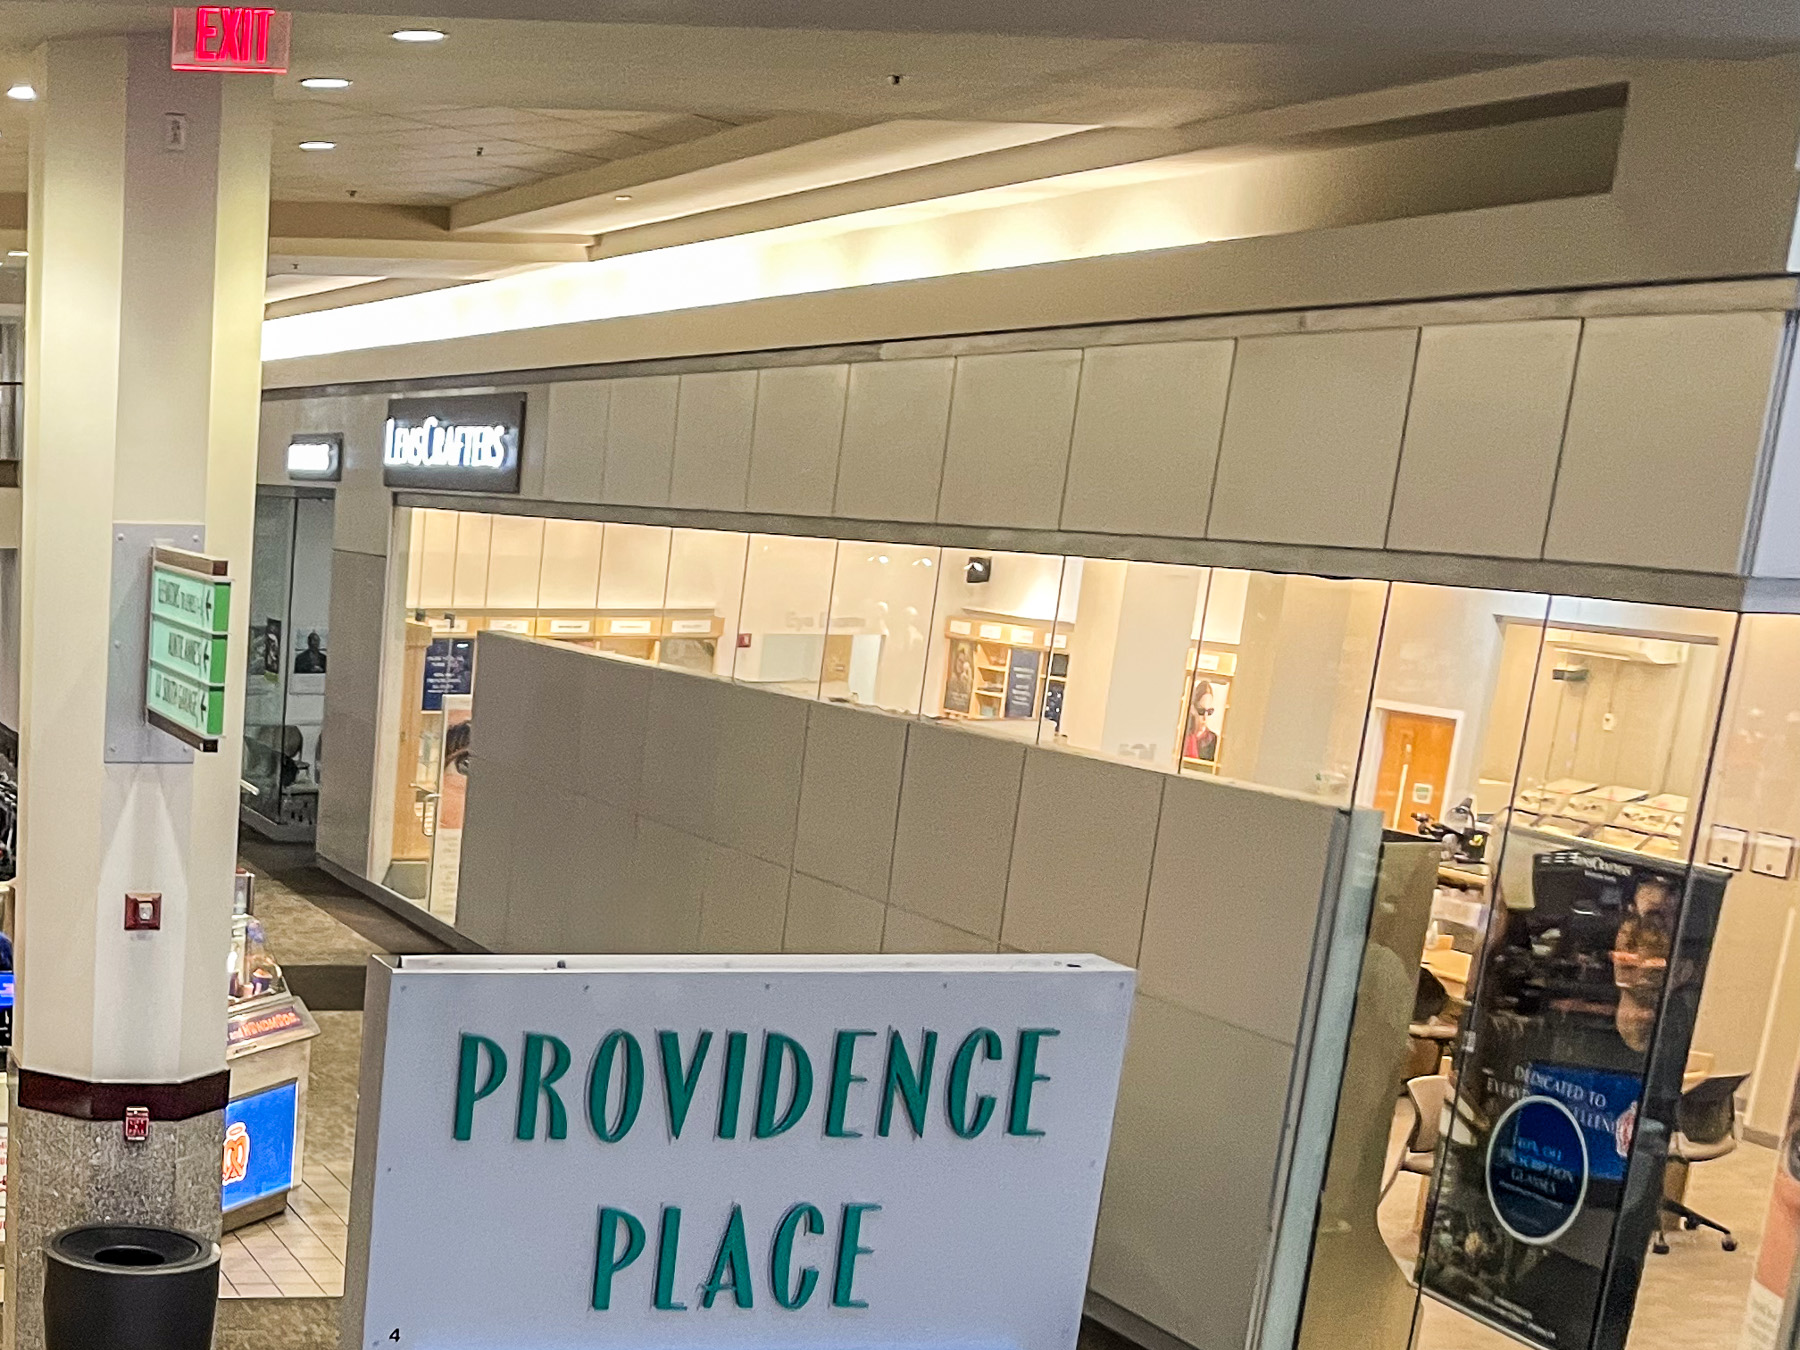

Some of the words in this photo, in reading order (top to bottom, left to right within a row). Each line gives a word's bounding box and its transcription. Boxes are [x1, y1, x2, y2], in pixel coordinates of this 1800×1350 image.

[195, 6, 275, 63] EXIT
[452, 1026, 1061, 1144] PROVIDENCE
[590, 1201, 883, 1311] PLACE
[389, 1328, 400, 1342] 4
